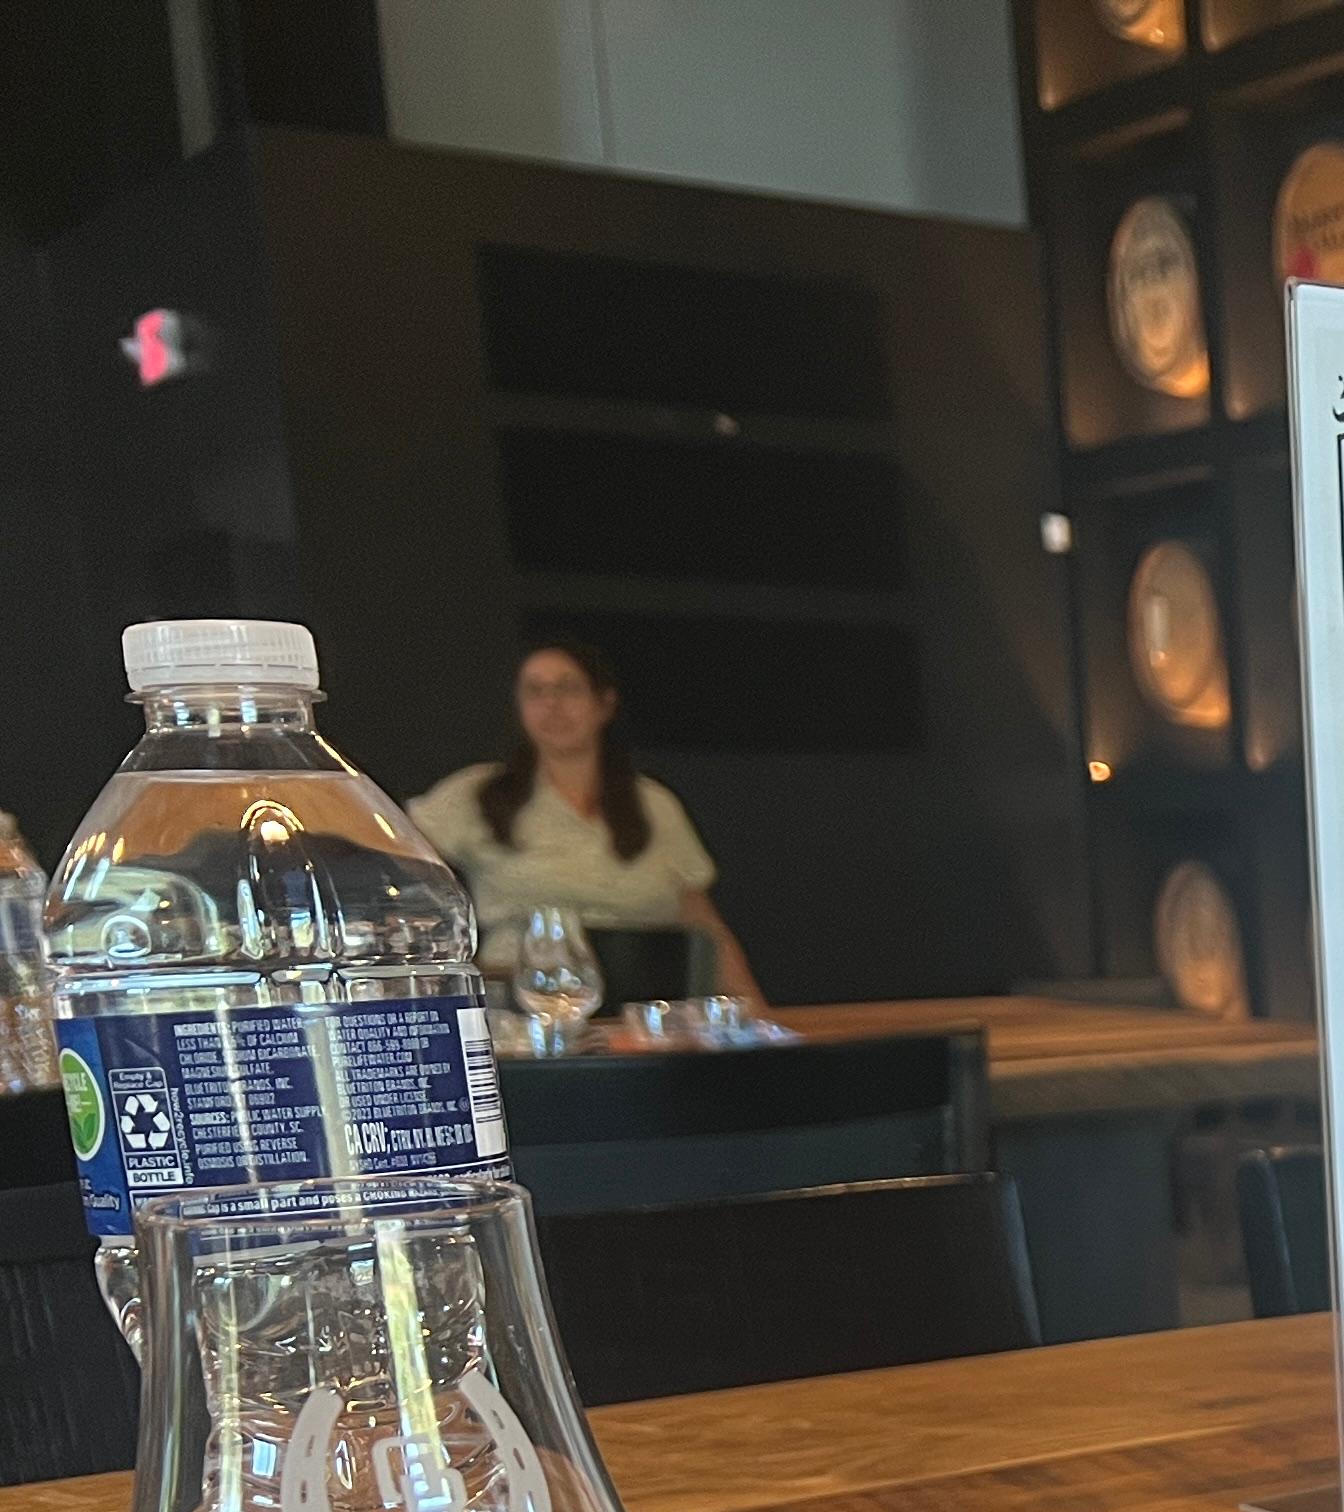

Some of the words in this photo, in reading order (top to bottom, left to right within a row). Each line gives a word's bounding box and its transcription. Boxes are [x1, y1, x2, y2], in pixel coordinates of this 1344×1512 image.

[129, 1156, 175, 1168] PLASTIC
[133, 1171, 176, 1183] BOTTLE
[238, 1198, 269, 1211] small
[271, 1196, 297, 1211] part
[299, 1193, 320, 1206] and
[322, 1193, 353, 1206] poses
